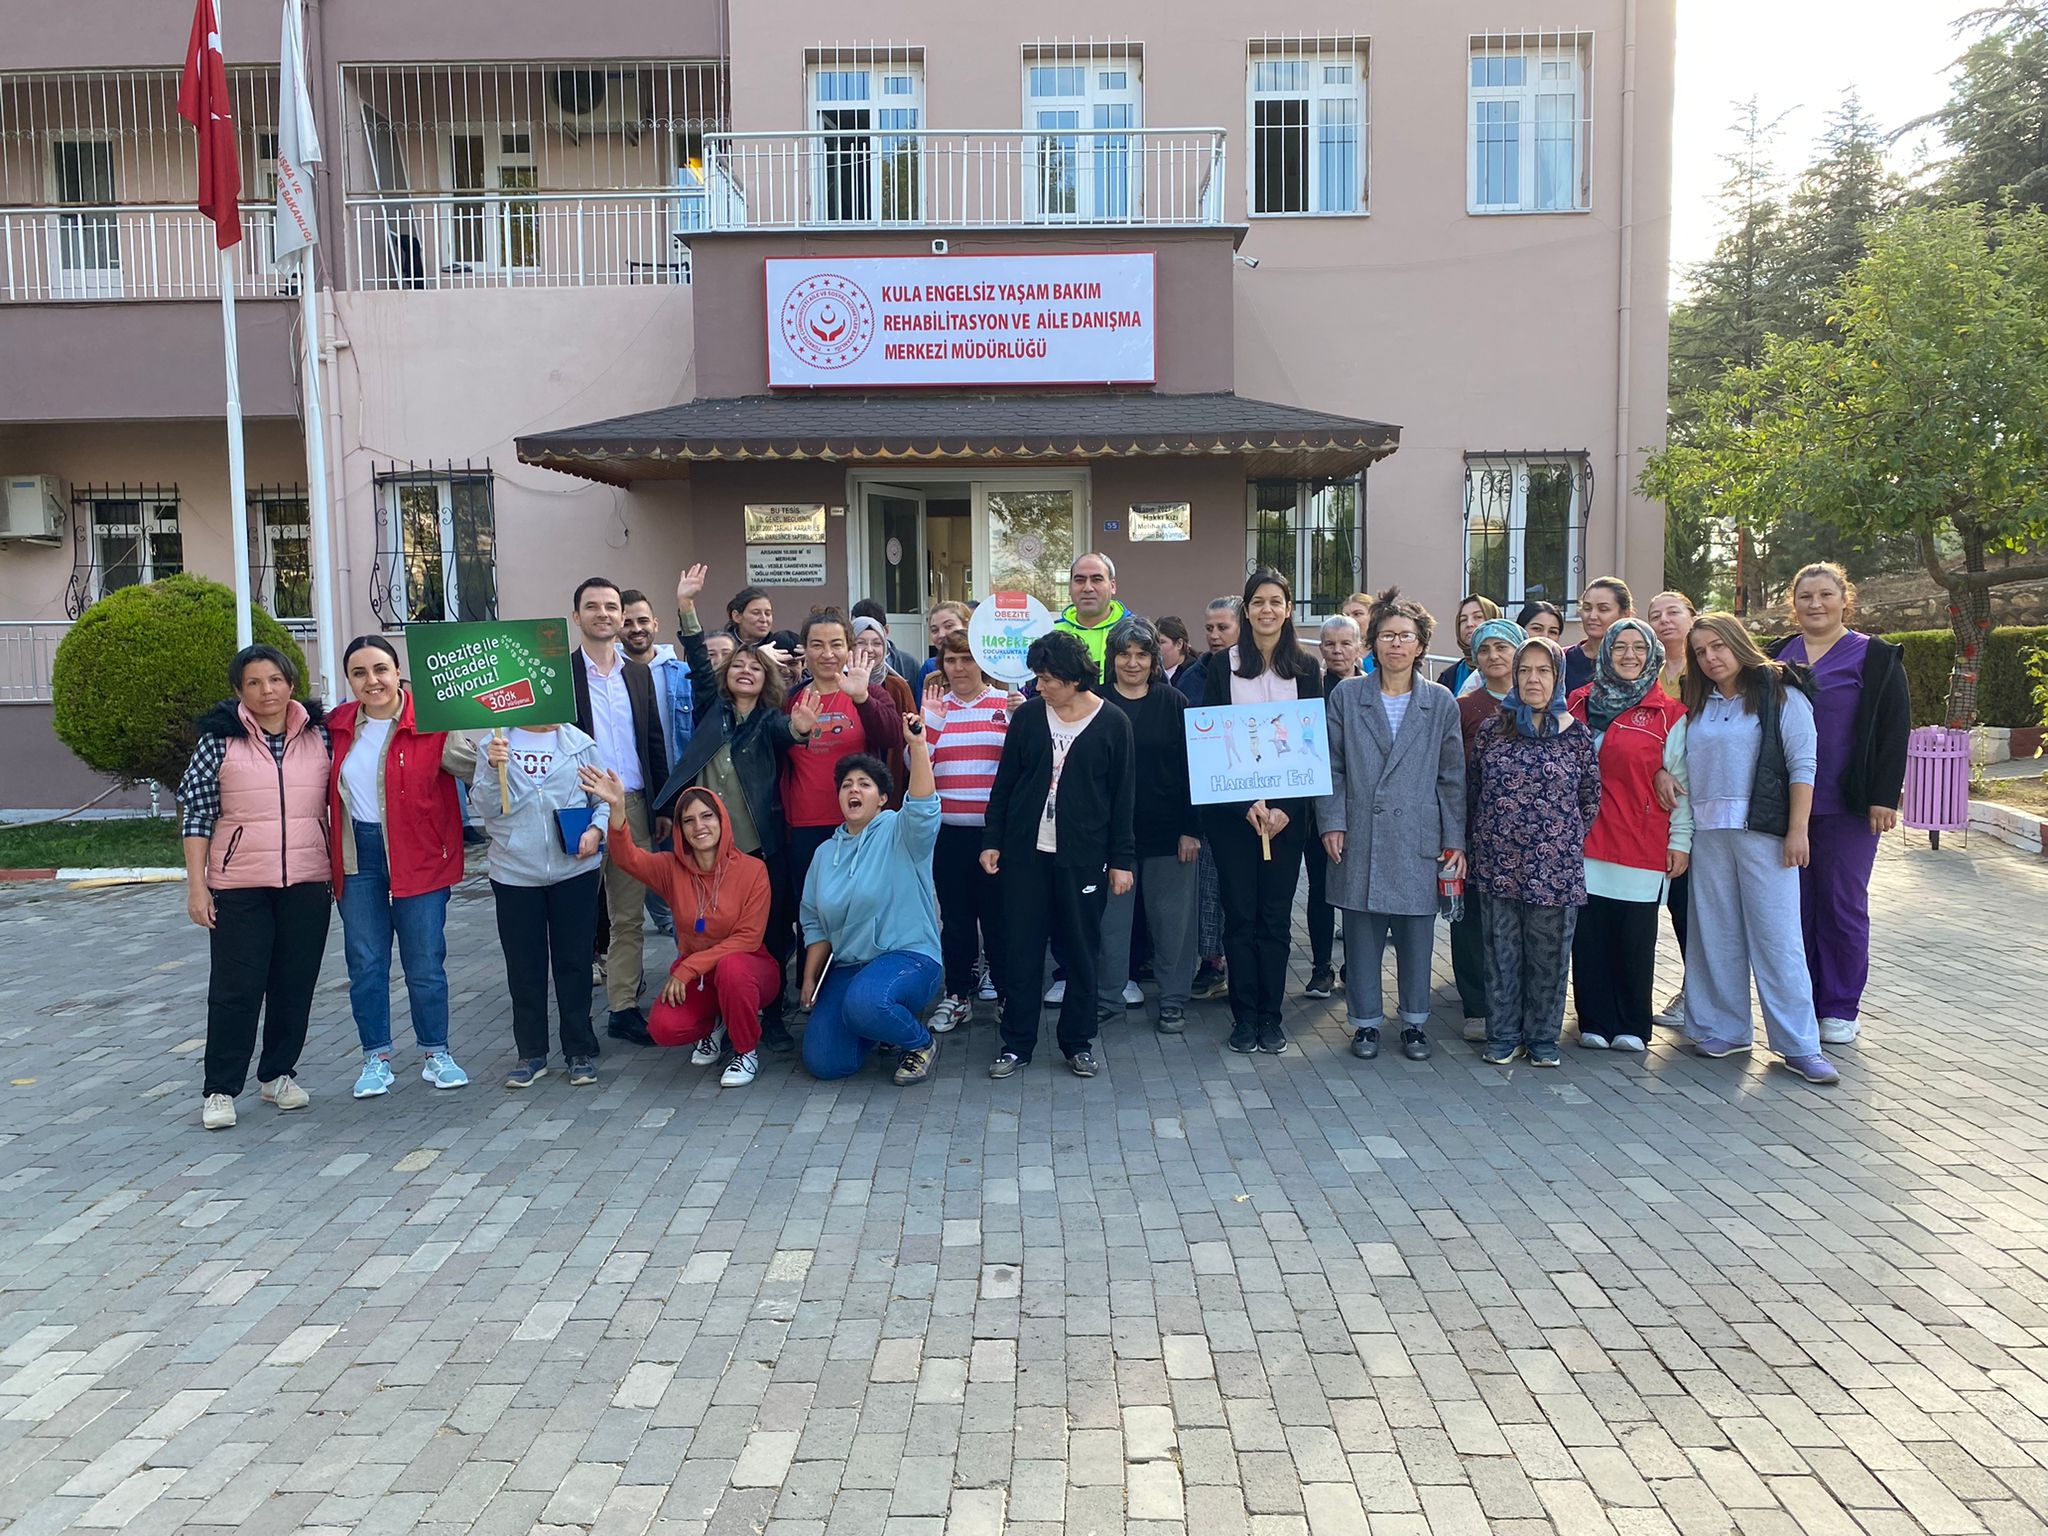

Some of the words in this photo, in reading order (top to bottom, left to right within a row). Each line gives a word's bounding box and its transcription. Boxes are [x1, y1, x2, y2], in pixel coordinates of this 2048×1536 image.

[291, 181, 303, 194] VE
[881, 285, 922, 302] KULA
[926, 281, 995, 302] ENGELSİZ
[998, 284, 1049, 305] YAŞAM
[1053, 282, 1101, 300] BAKIM
[883, 310, 1009, 331] REHABİLİTASYON
[1011, 313, 1031, 330] VE
[1037, 309, 1069, 329] AİLE
[1072, 310, 1142, 332] DANIŞMA
[885, 339, 947, 360] MERKEZİ
[951, 338, 1047, 359] MÜDÜRLÜĞÜ
[1107, 522, 1118, 530] 55
[426, 642, 481, 671] Obezite
[482, 637, 500, 652] ile
[431, 653, 499, 687] mücadele
[436, 666, 500, 701] ediyoruz!
[489, 694, 506, 710] 30
[505, 690, 517, 702] dk
